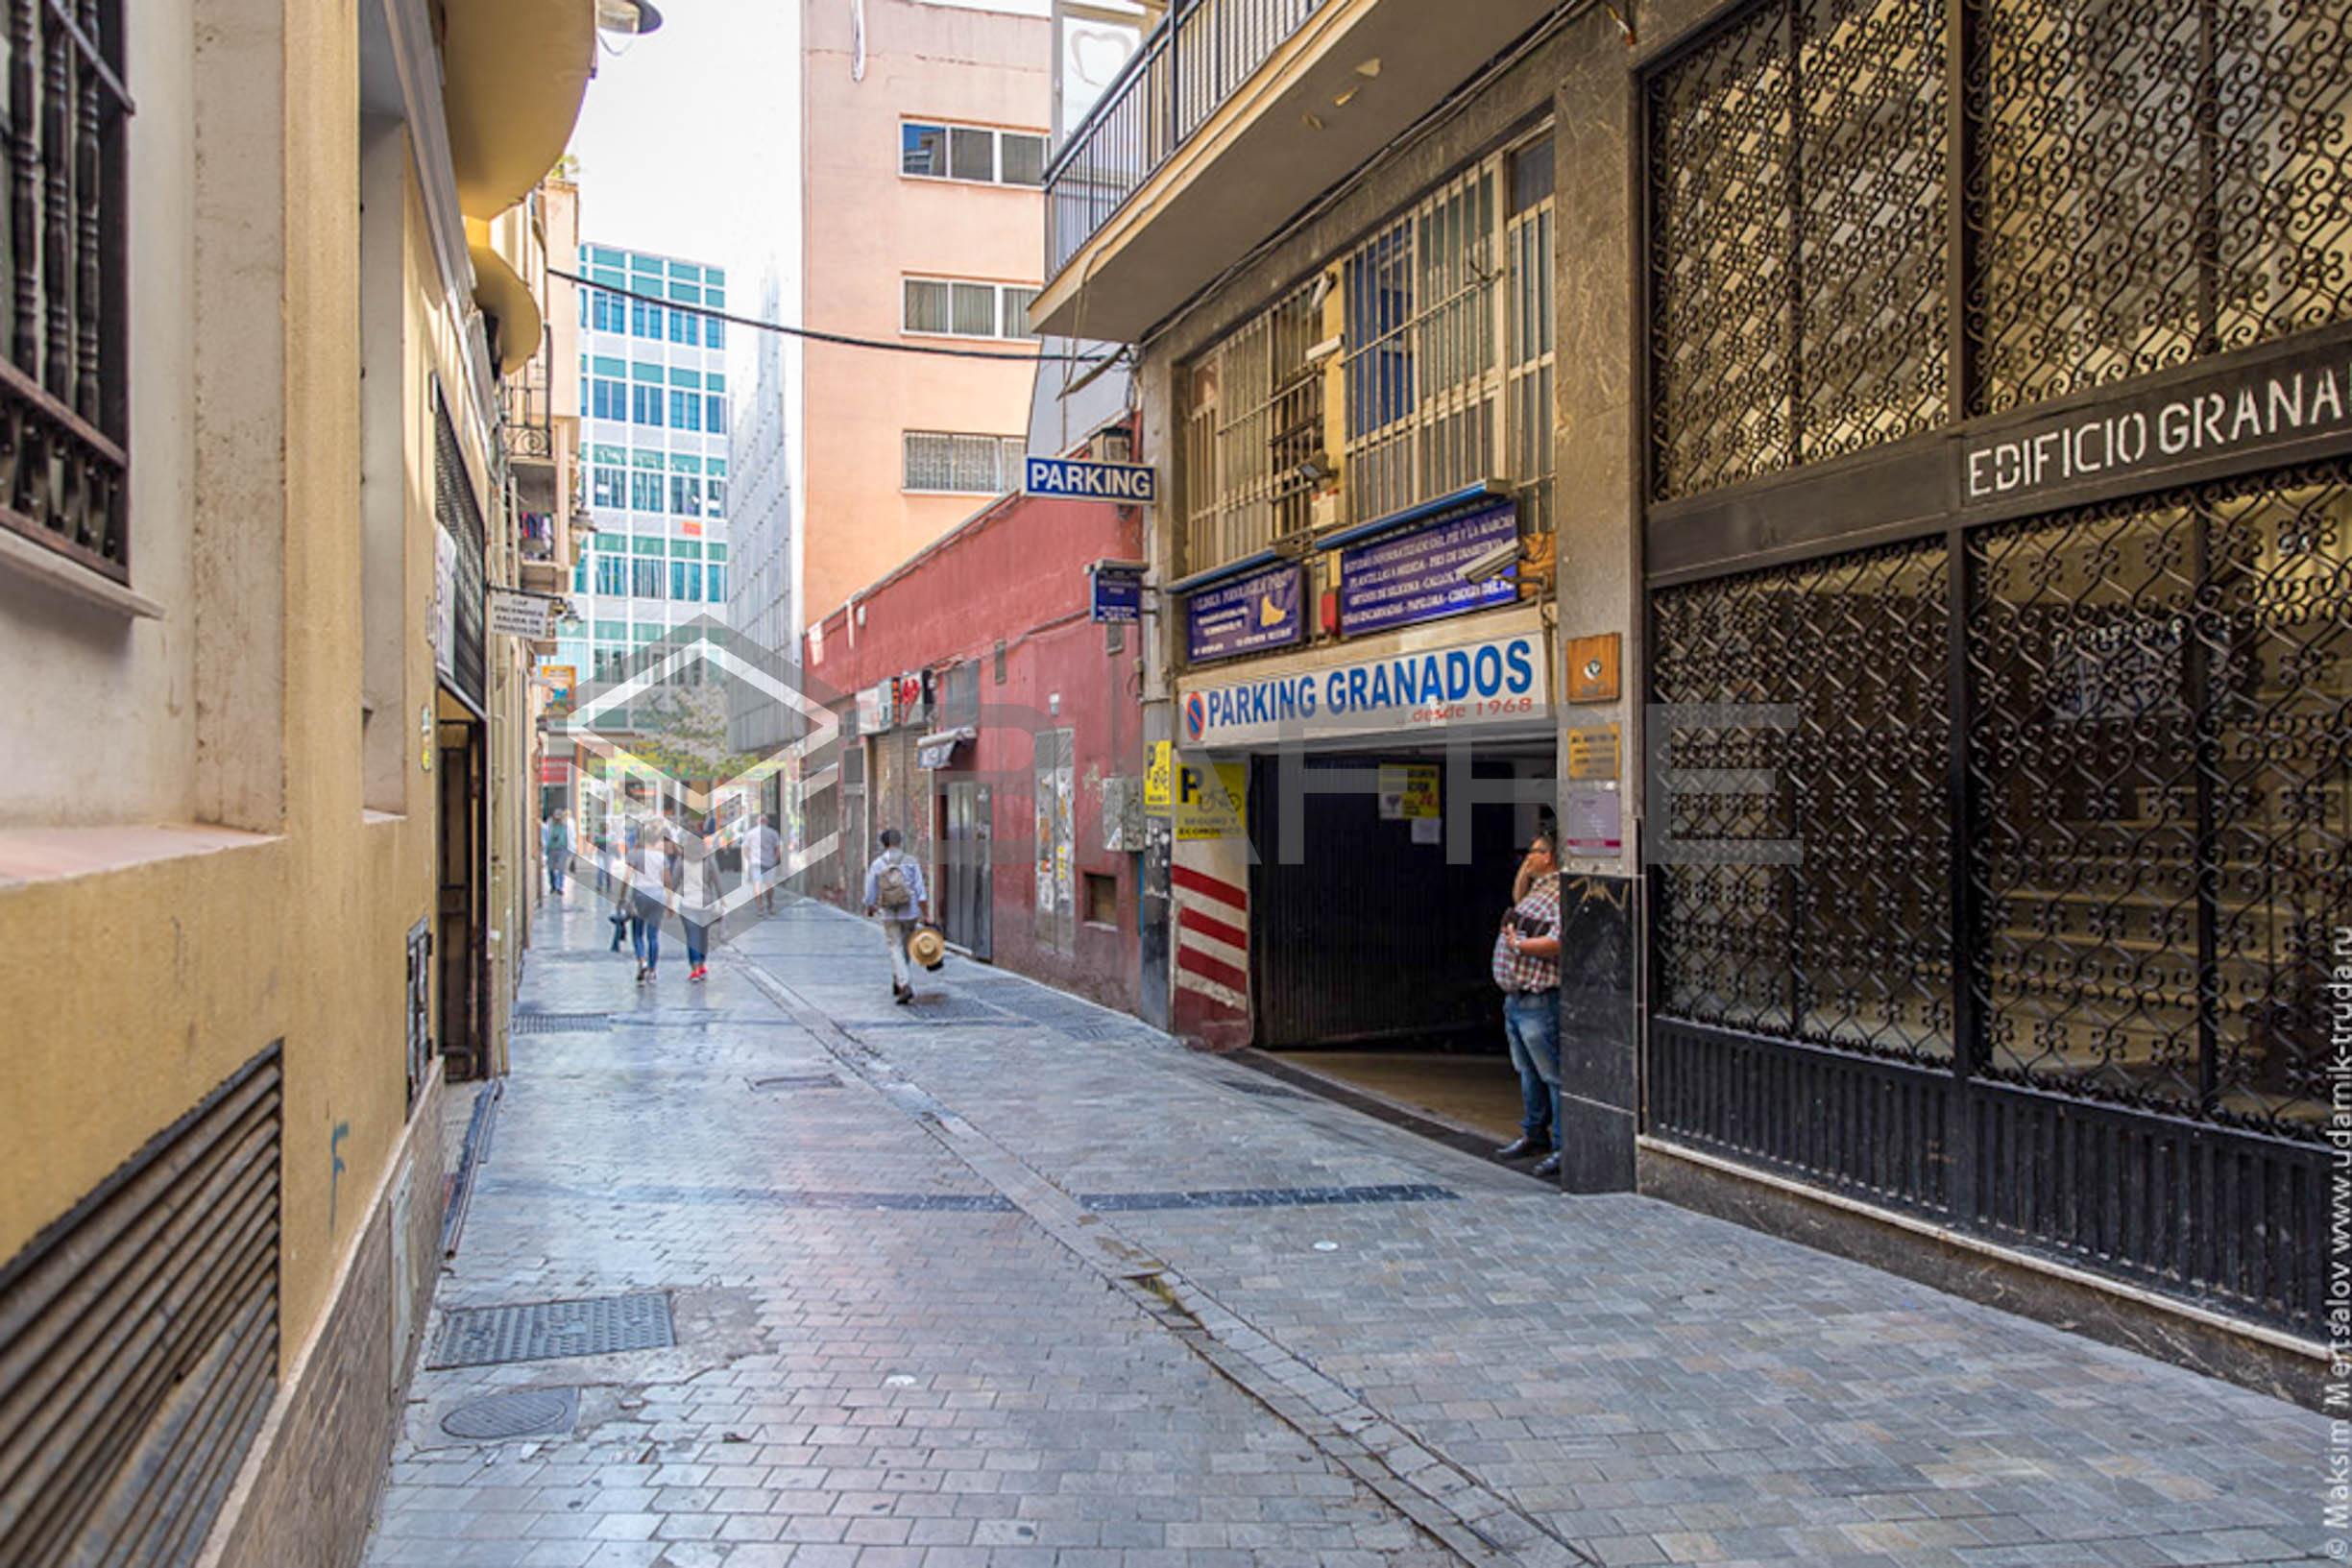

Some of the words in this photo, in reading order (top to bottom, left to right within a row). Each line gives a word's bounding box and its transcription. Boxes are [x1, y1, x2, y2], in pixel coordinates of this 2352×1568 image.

[1969, 413, 2146, 496] EDIFICIO
[2158, 361, 2352, 455] GRANA
[1031, 463, 1152, 497] PARKING
[1208, 676, 1315, 728] PARKING
[1326, 639, 1533, 715] GRANADOS
[1476, 697, 1533, 716] 1968
[1181, 765, 1203, 803] P
